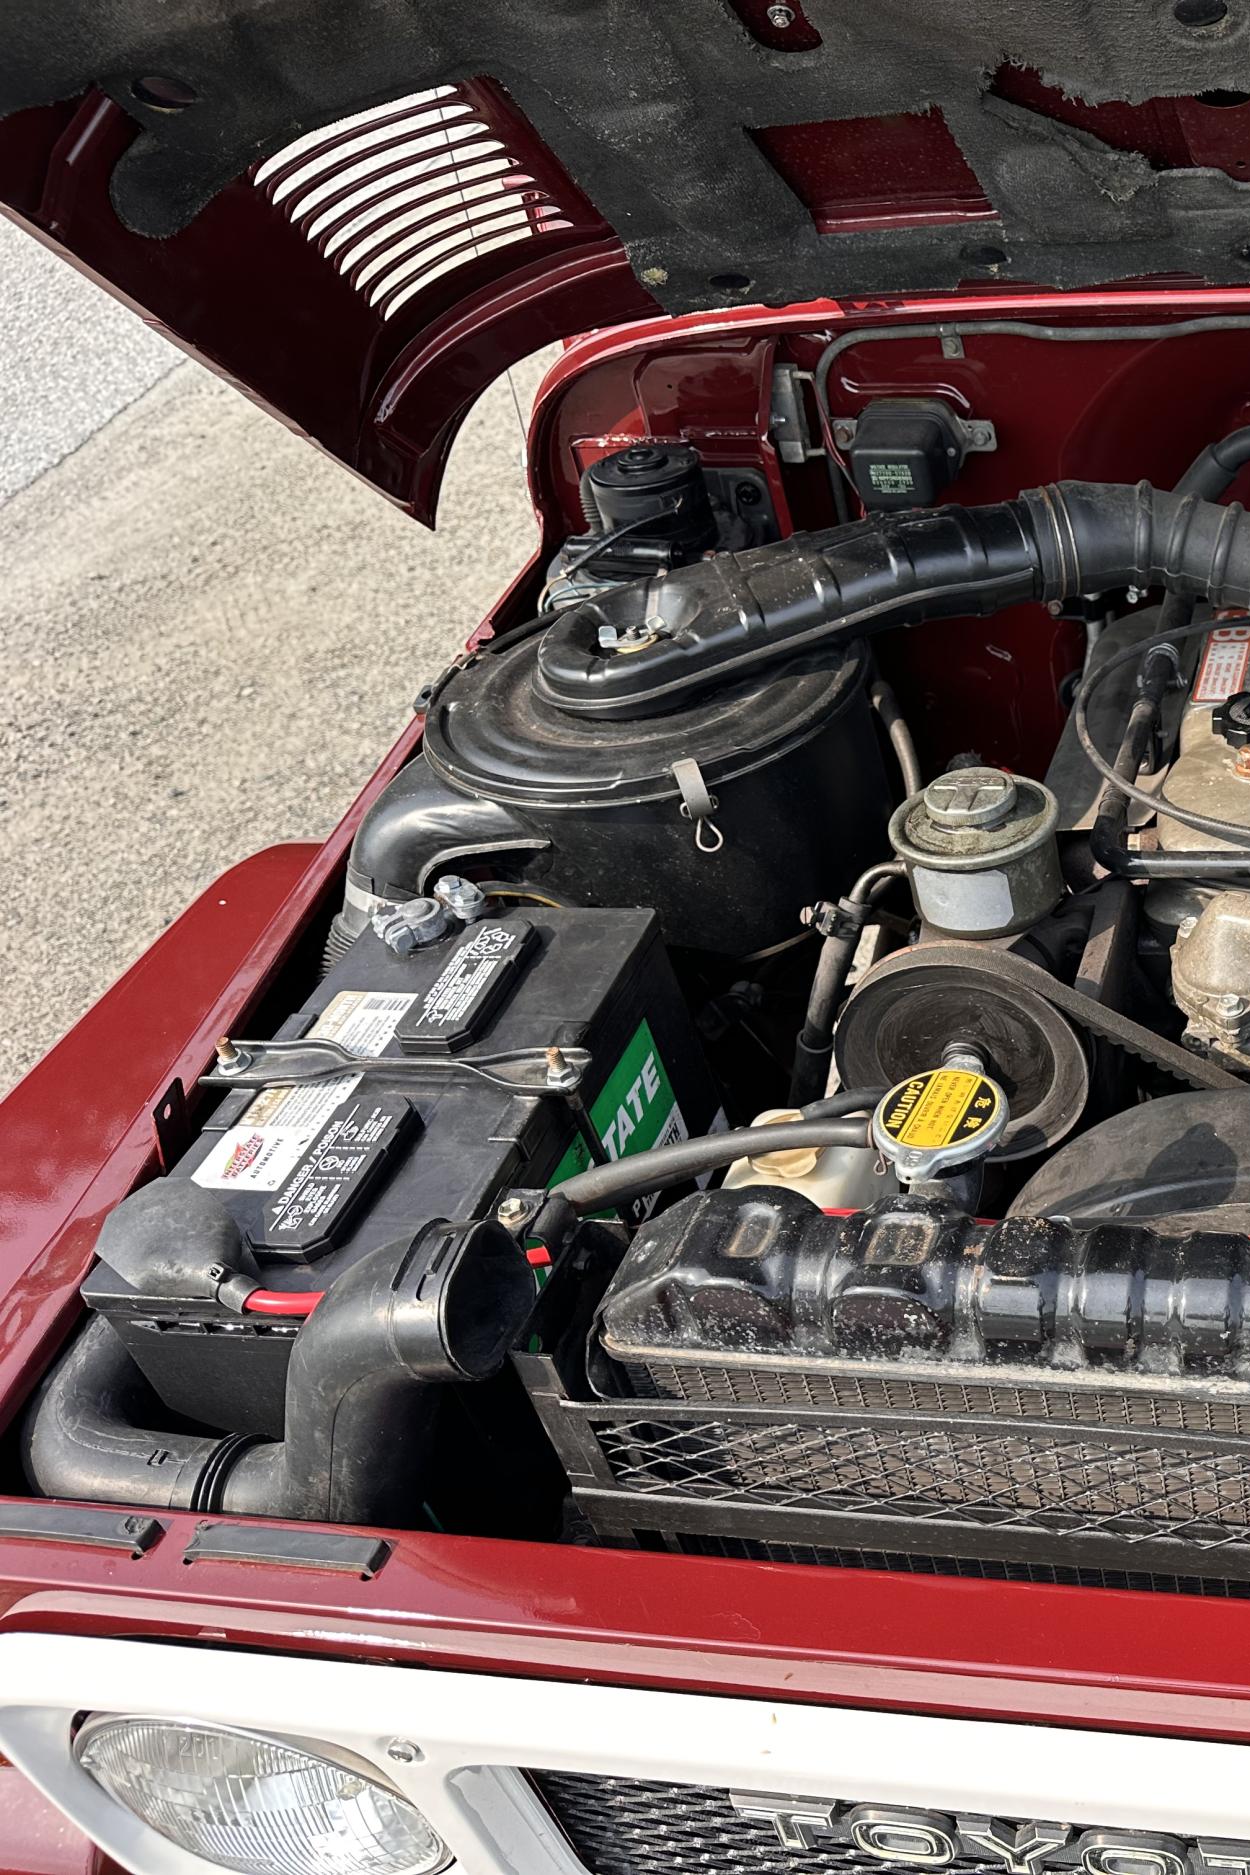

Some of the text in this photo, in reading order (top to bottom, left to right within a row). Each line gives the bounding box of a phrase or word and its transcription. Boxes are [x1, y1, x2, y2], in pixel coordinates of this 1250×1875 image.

[587, 1051, 661, 1171] TATE
[886, 1081, 924, 1129] CAUTION
[222, 1132, 258, 1178] INTERSTATE
[231, 1136, 263, 1176] BATTERIES
[250, 1137, 283, 1178] AUTOMOTIVE
[277, 1163, 313, 1204] DANGER
[312, 1120, 344, 1154] POISON
